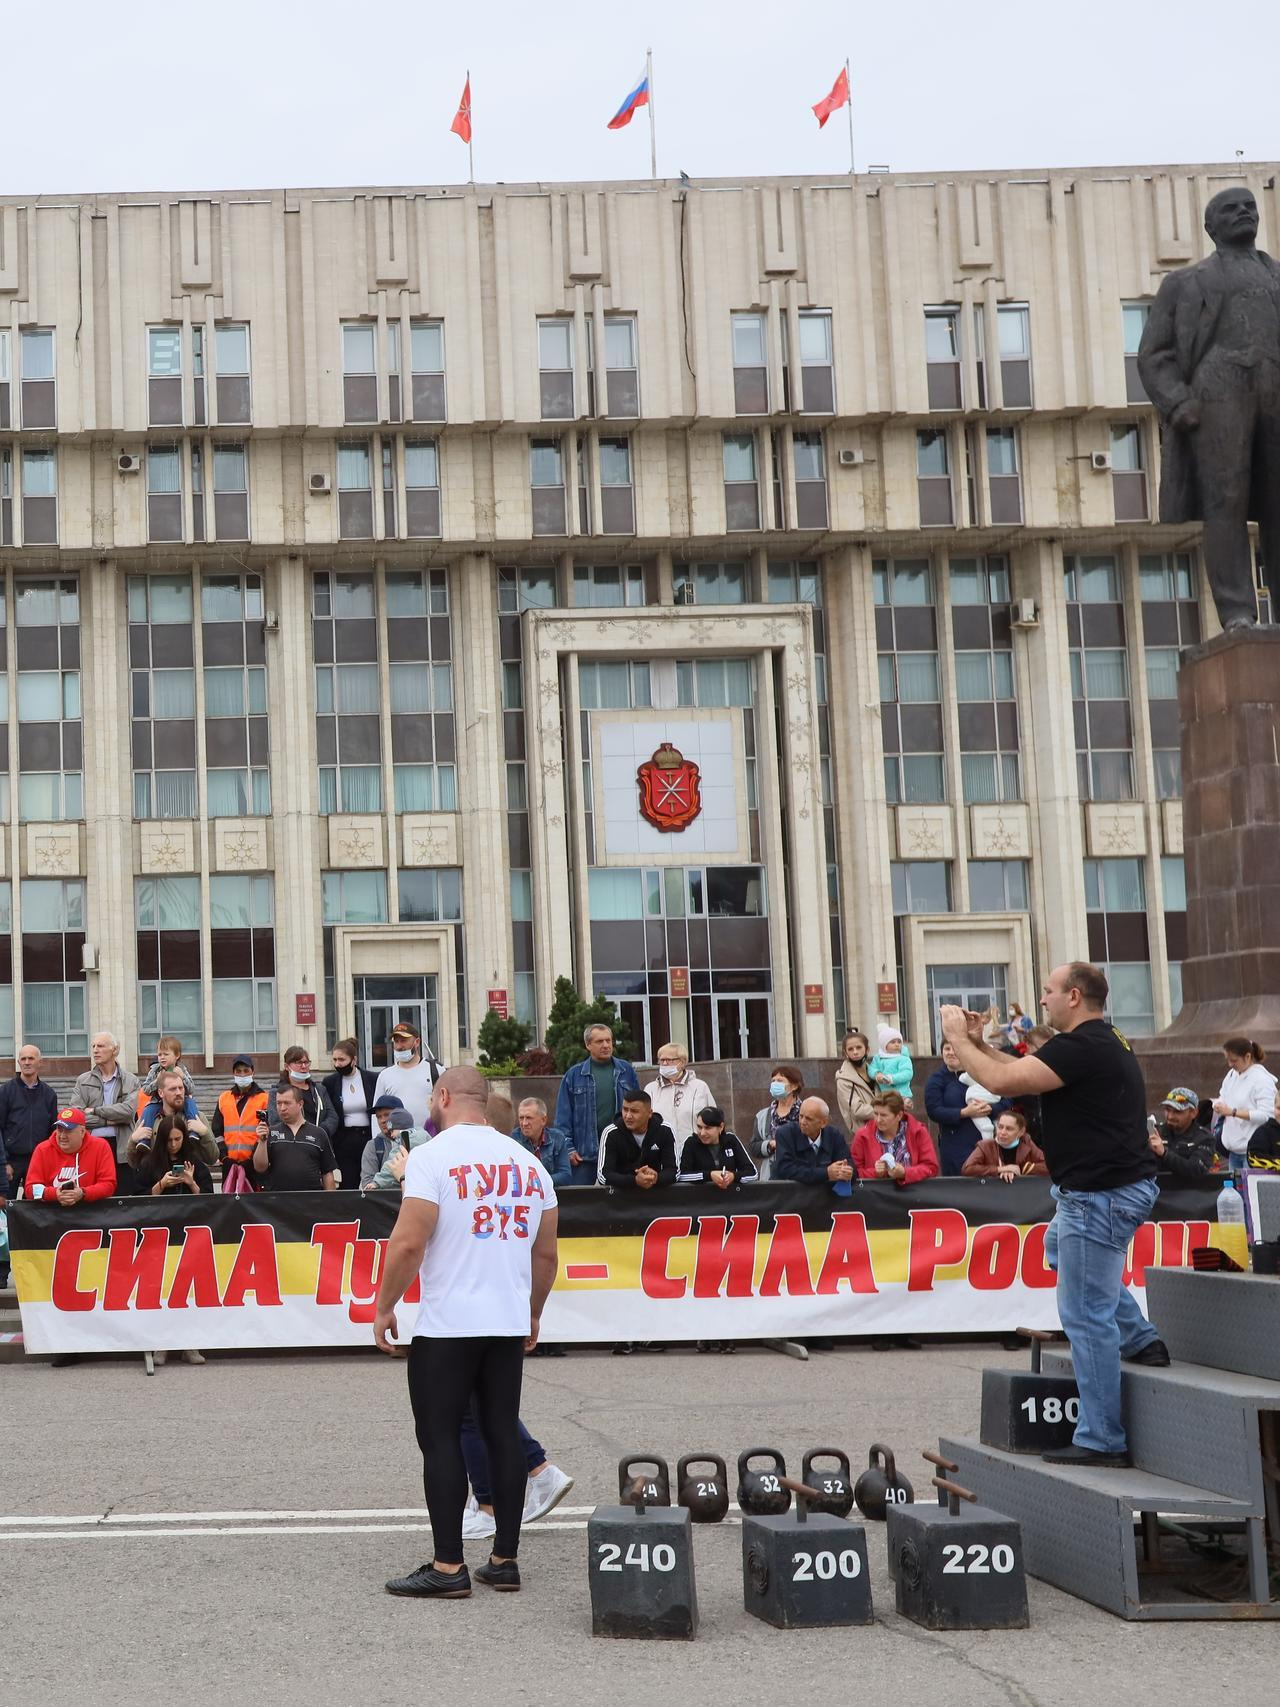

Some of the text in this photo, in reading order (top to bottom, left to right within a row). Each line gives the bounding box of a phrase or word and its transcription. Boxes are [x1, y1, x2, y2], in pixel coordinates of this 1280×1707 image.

[449, 1157, 544, 1200] ТУЛА
[472, 1203, 531, 1241] 875
[51, 1223, 284, 1312] СИЛА
[640, 1211, 880, 1300] СИЛА
[1021, 1396, 1080, 1424] 180
[696, 1482, 718, 1497] 24
[760, 1475, 781, 1493] 32
[823, 1480, 844, 1494] 32
[598, 1543, 676, 1572] 240
[792, 1549, 861, 1582] 200
[942, 1544, 1016, 1574] 220
